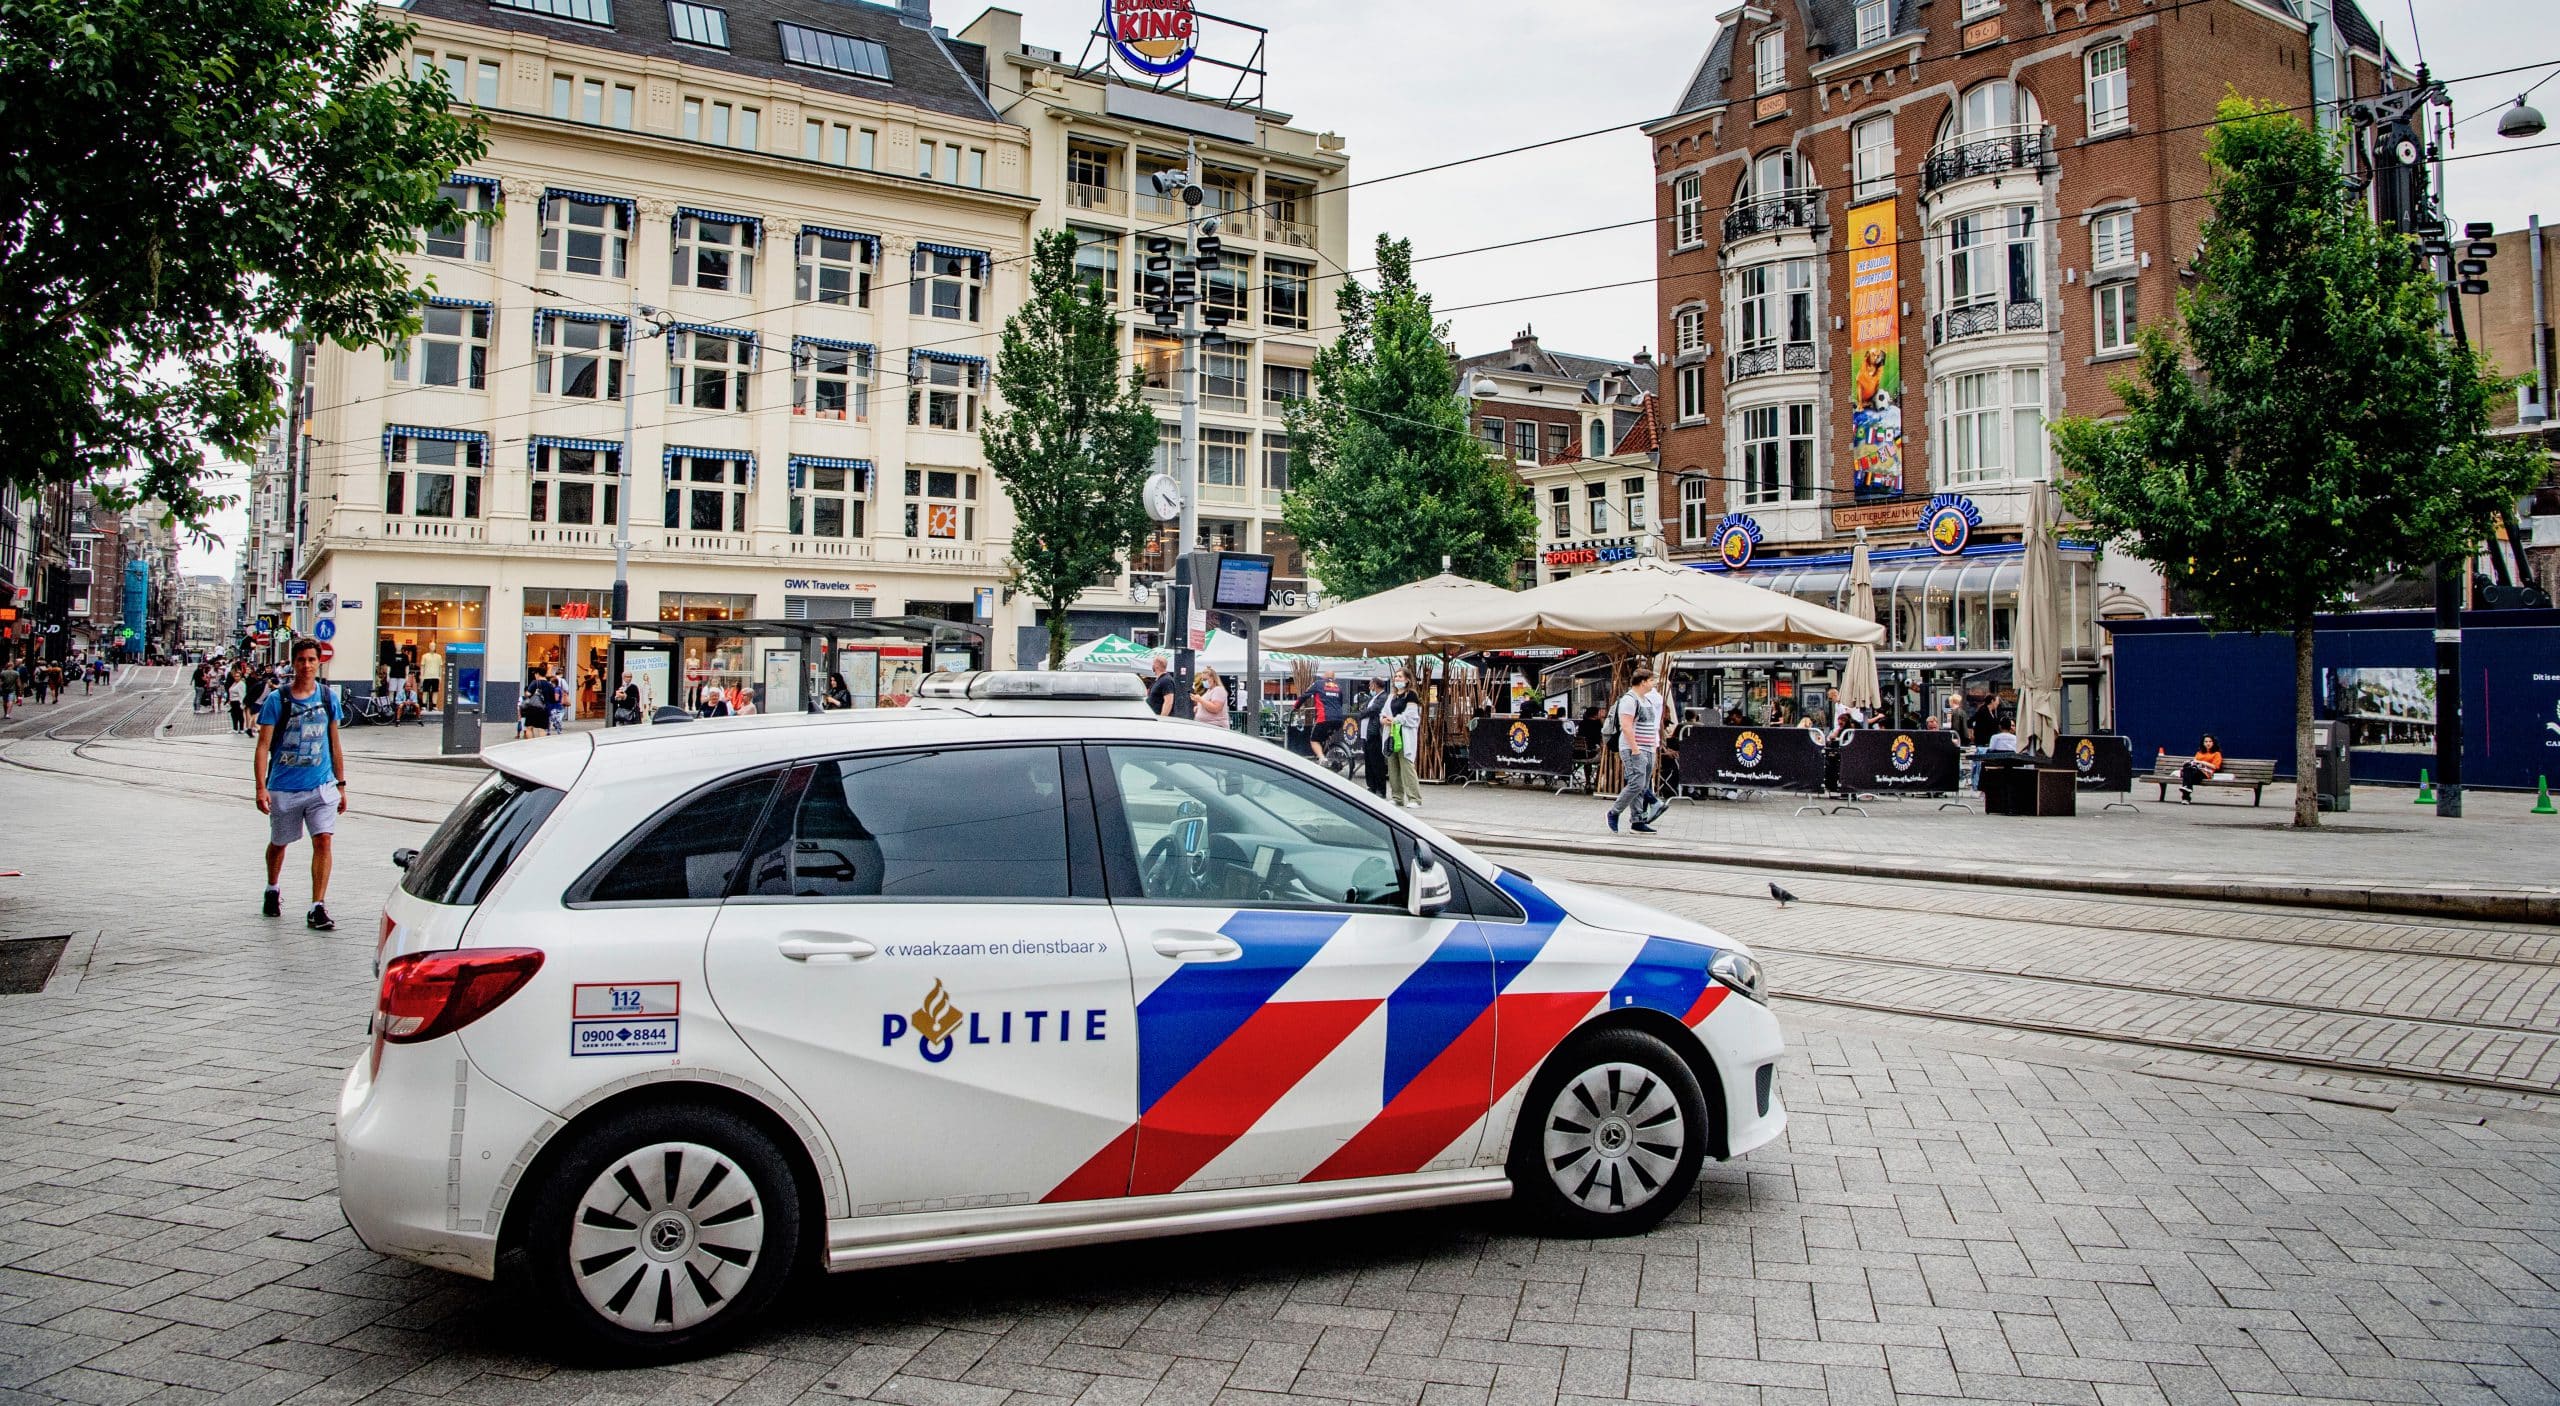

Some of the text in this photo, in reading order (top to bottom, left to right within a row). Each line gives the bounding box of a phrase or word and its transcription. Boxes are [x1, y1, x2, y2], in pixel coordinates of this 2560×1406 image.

[1117, 11, 1193, 41] KING
[1857, 256, 1890, 273] THE BULLDOG
[1855, 270, 1893, 288] SUPPORTS OUR
[1918, 494, 1983, 531] THE BULLDOG
[1711, 513, 1763, 547] THE BULLDOG
[1545, 547, 1635, 565] SPORTS CAFE
[784, 579, 850, 591] GWK Travelex
[1269, 590, 1296, 607] NG
[1791, 662, 1815, 670] PALACE
[1891, 661, 1938, 669] COFFEESHOP
[2533, 673, 2544, 681] Dit
[2545, 673, 2551, 681] is
[1742, 731, 1763, 749] BULLDOG
[1736, 753, 1762, 768] AMSTERDAM
[900, 941, 986, 957] waakzaam
[989, 943, 1009, 955] en
[1012, 939, 1095, 954] dienstbaar
[582, 1028, 666, 1042] 0900 8844
[882, 1009, 1107, 1062] POLITIE
